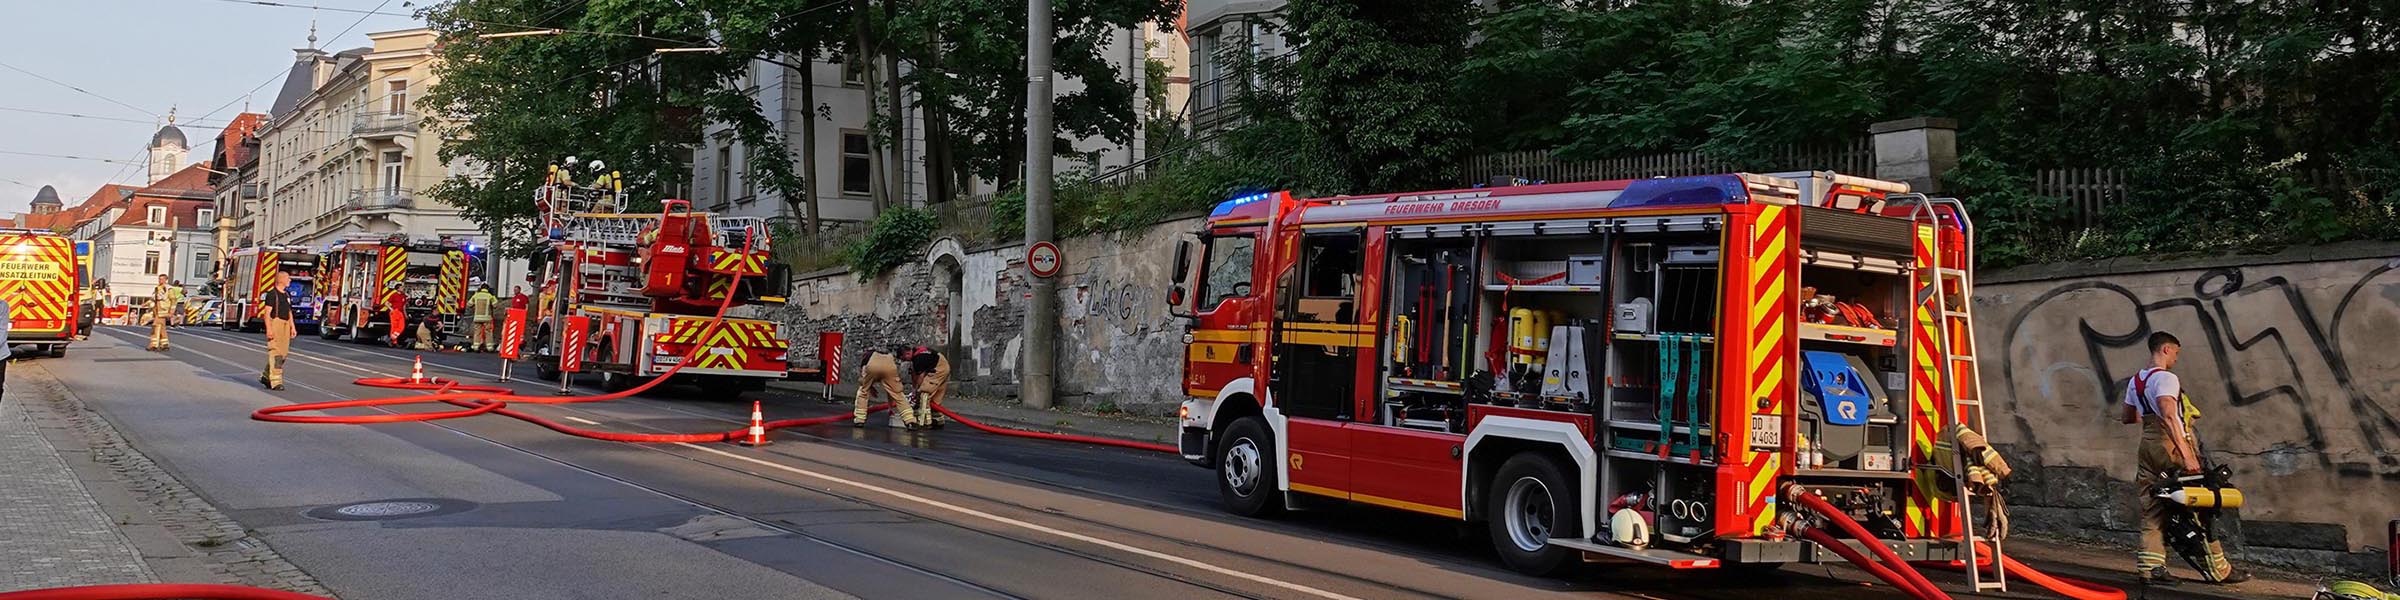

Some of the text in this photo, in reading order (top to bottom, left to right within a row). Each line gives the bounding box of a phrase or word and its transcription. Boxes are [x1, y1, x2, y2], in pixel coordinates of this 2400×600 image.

[1384, 199, 1502, 215] FEUERWEHR DRESDEN
[1285, 235, 1294, 260] 1
[1, 262, 50, 271] FEUERWEHR
[665, 273, 672, 286] 1
[47, 320, 54, 329] 5
[1752, 416, 1763, 430] DD
